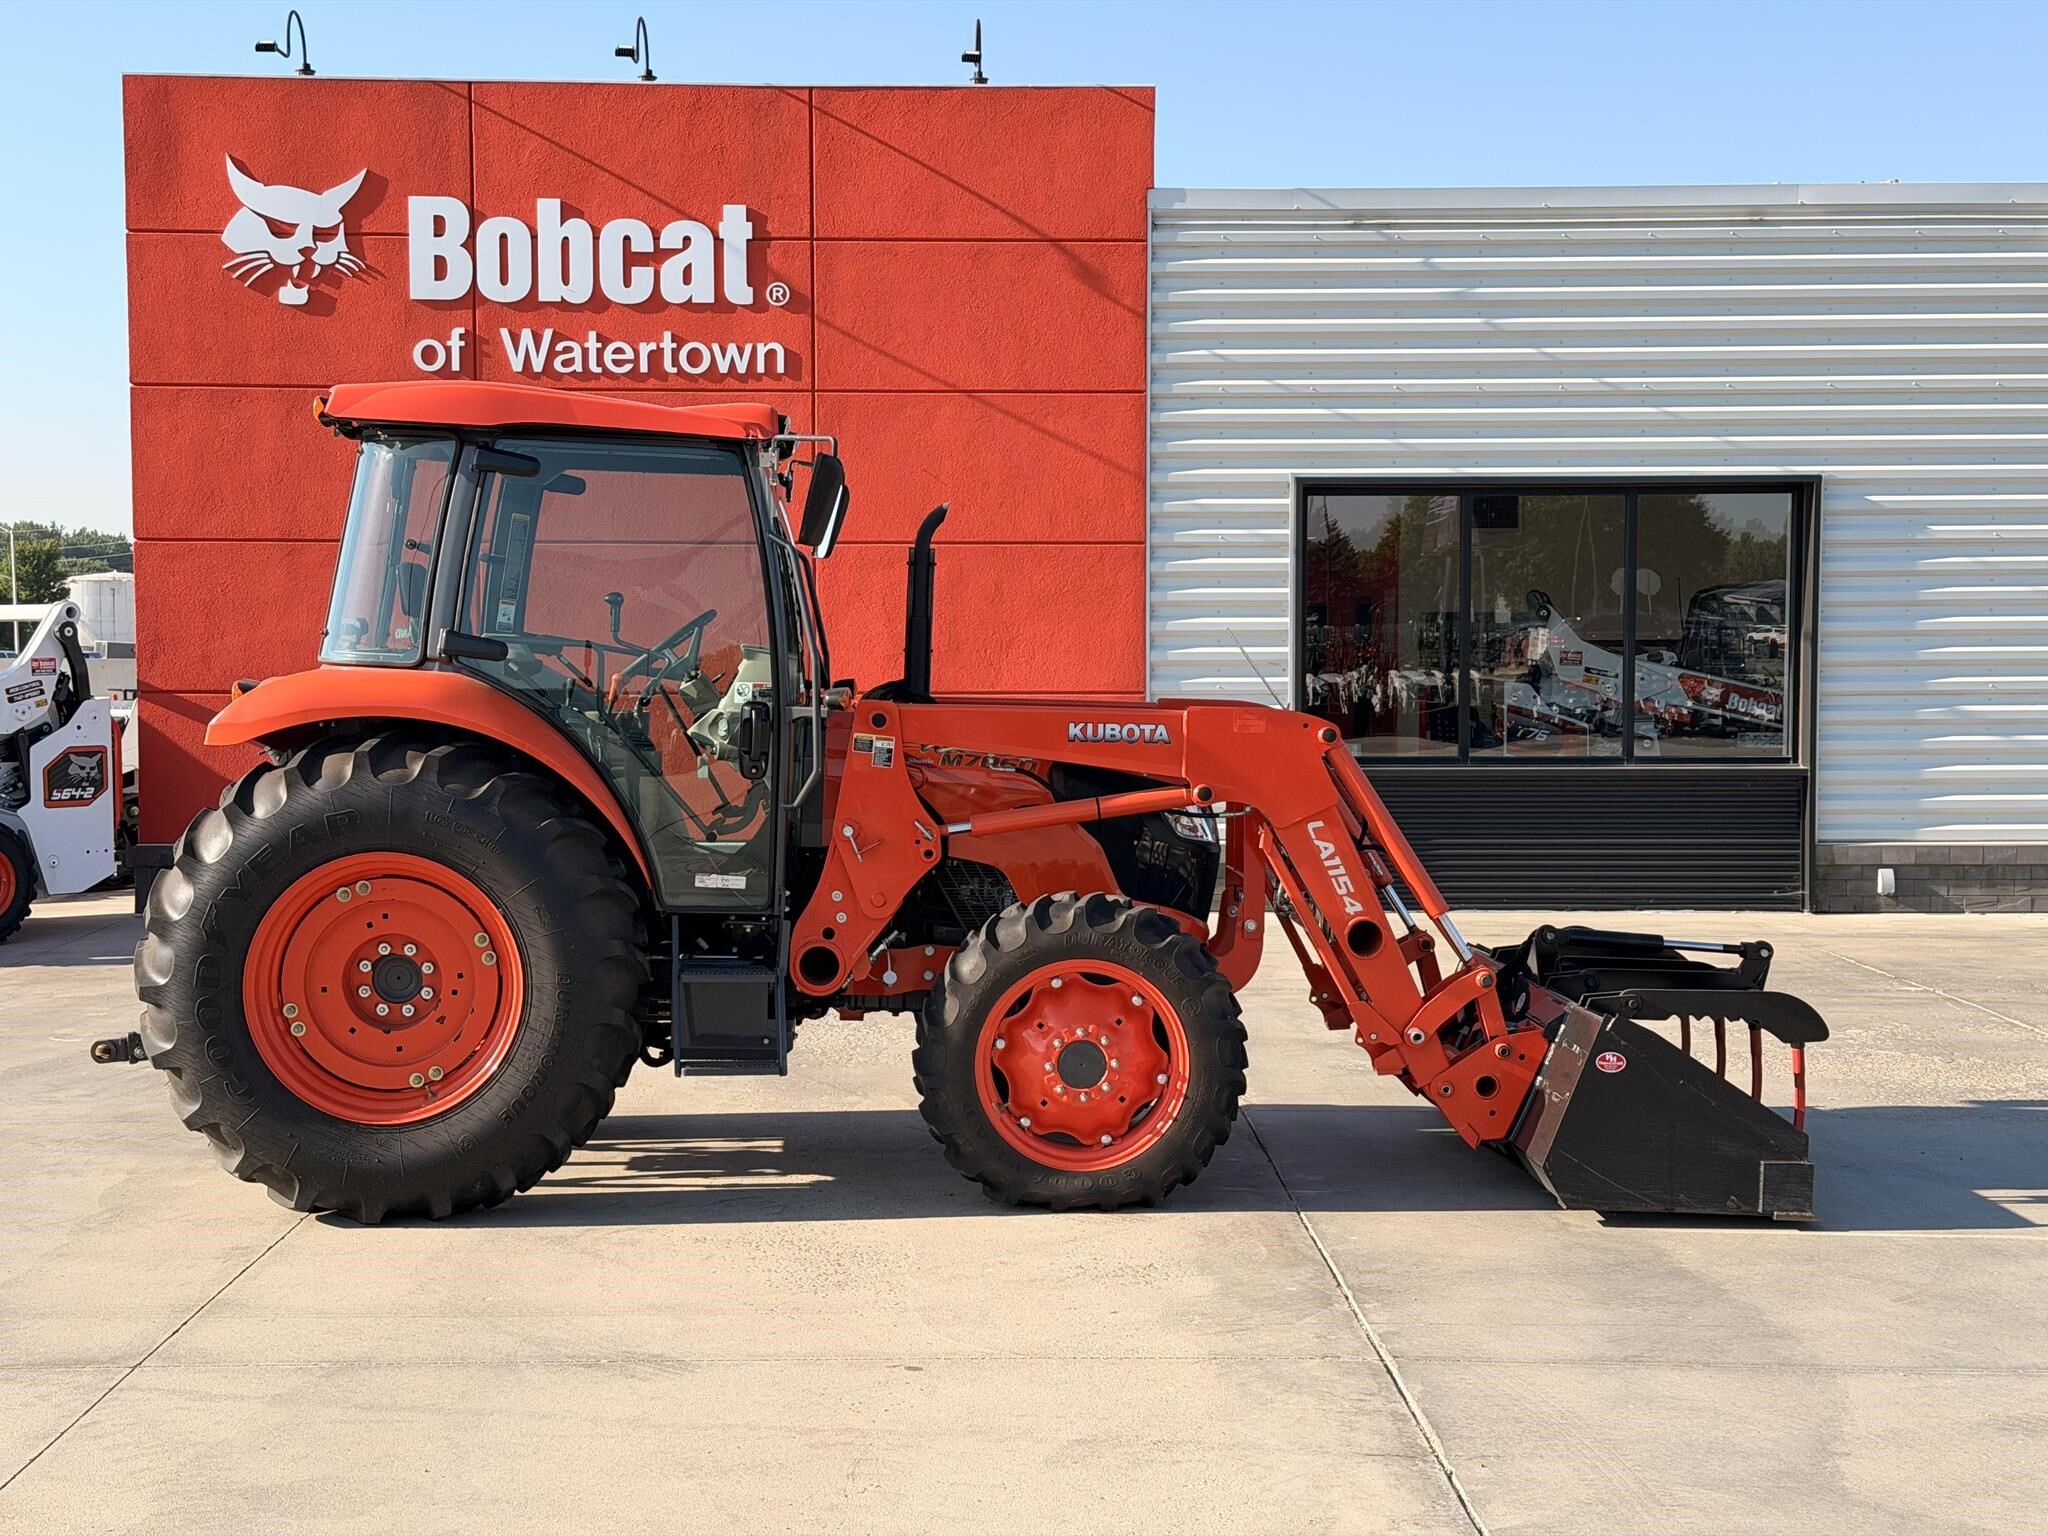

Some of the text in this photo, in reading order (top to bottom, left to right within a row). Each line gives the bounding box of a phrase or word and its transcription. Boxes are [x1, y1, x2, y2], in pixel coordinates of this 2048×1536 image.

[408, 195, 754, 306] Bobcat
[412, 327, 786, 375] of Watertown
[1068, 723, 1171, 743] KUBOTA
[50, 786, 95, 801] S64-2
[1307, 820, 1363, 915] LA1154
[193, 808, 361, 1105] GOODYEAR
